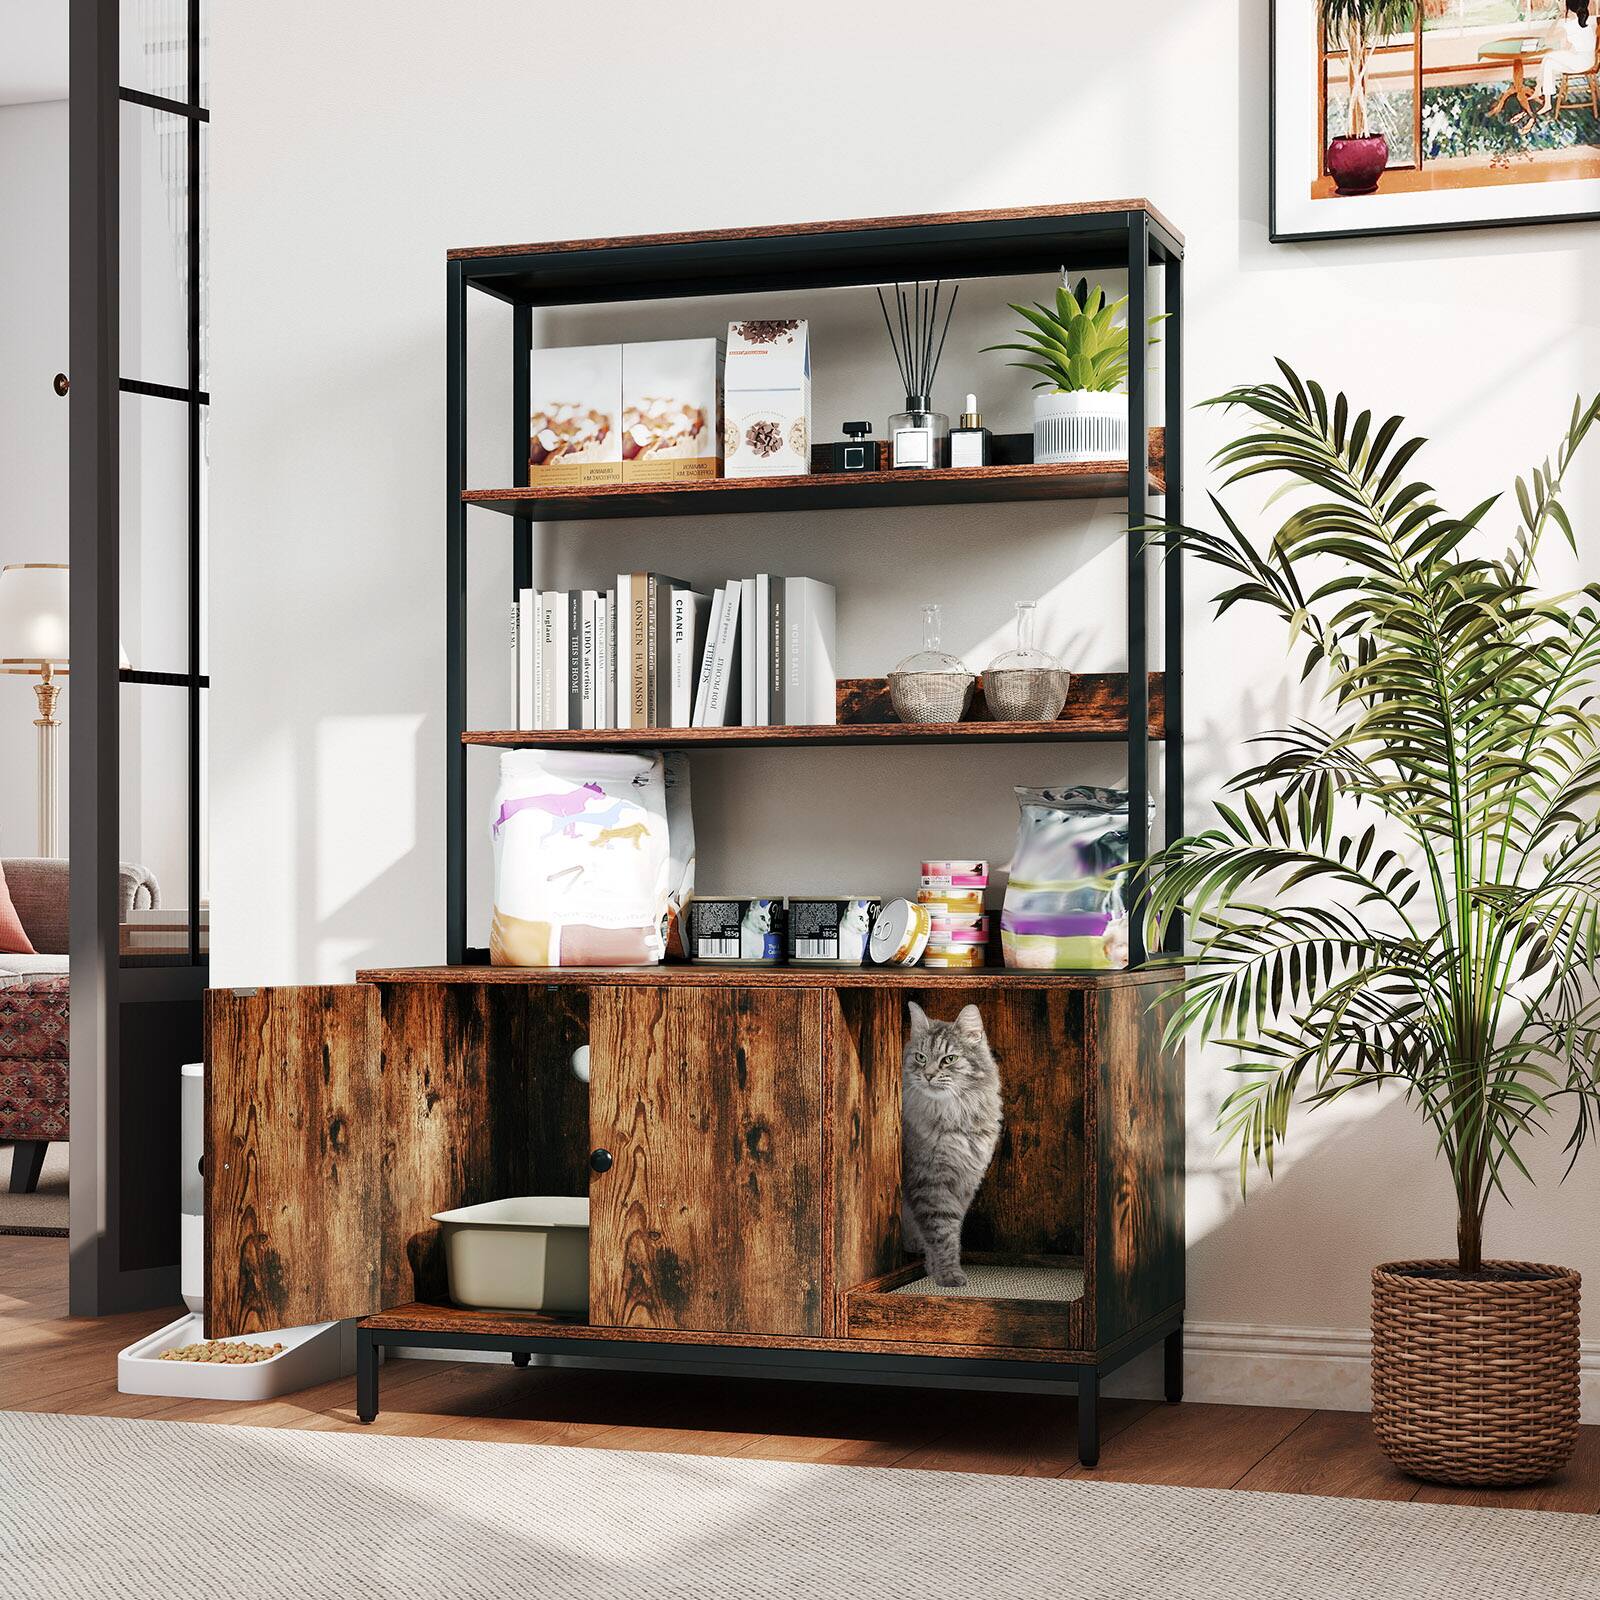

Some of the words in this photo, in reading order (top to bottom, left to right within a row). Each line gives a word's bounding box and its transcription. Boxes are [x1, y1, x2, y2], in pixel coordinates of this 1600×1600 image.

[544, 609, 553, 643] England
[584, 618, 592, 655] AVEDON
[635, 599, 643, 646] KONSTEN
[675, 599, 684, 644] CHANEL
[571, 635, 579, 656] THIS
[571, 657, 579, 666] IS
[583, 657, 592, 700] advertising
[702, 641, 716, 684] SCHIELE
[714, 657, 725, 690] PICOULT
[571, 667, 579, 694] HOME
[724, 930, 739, 938] 185g
[822, 930, 838, 938] 185g
